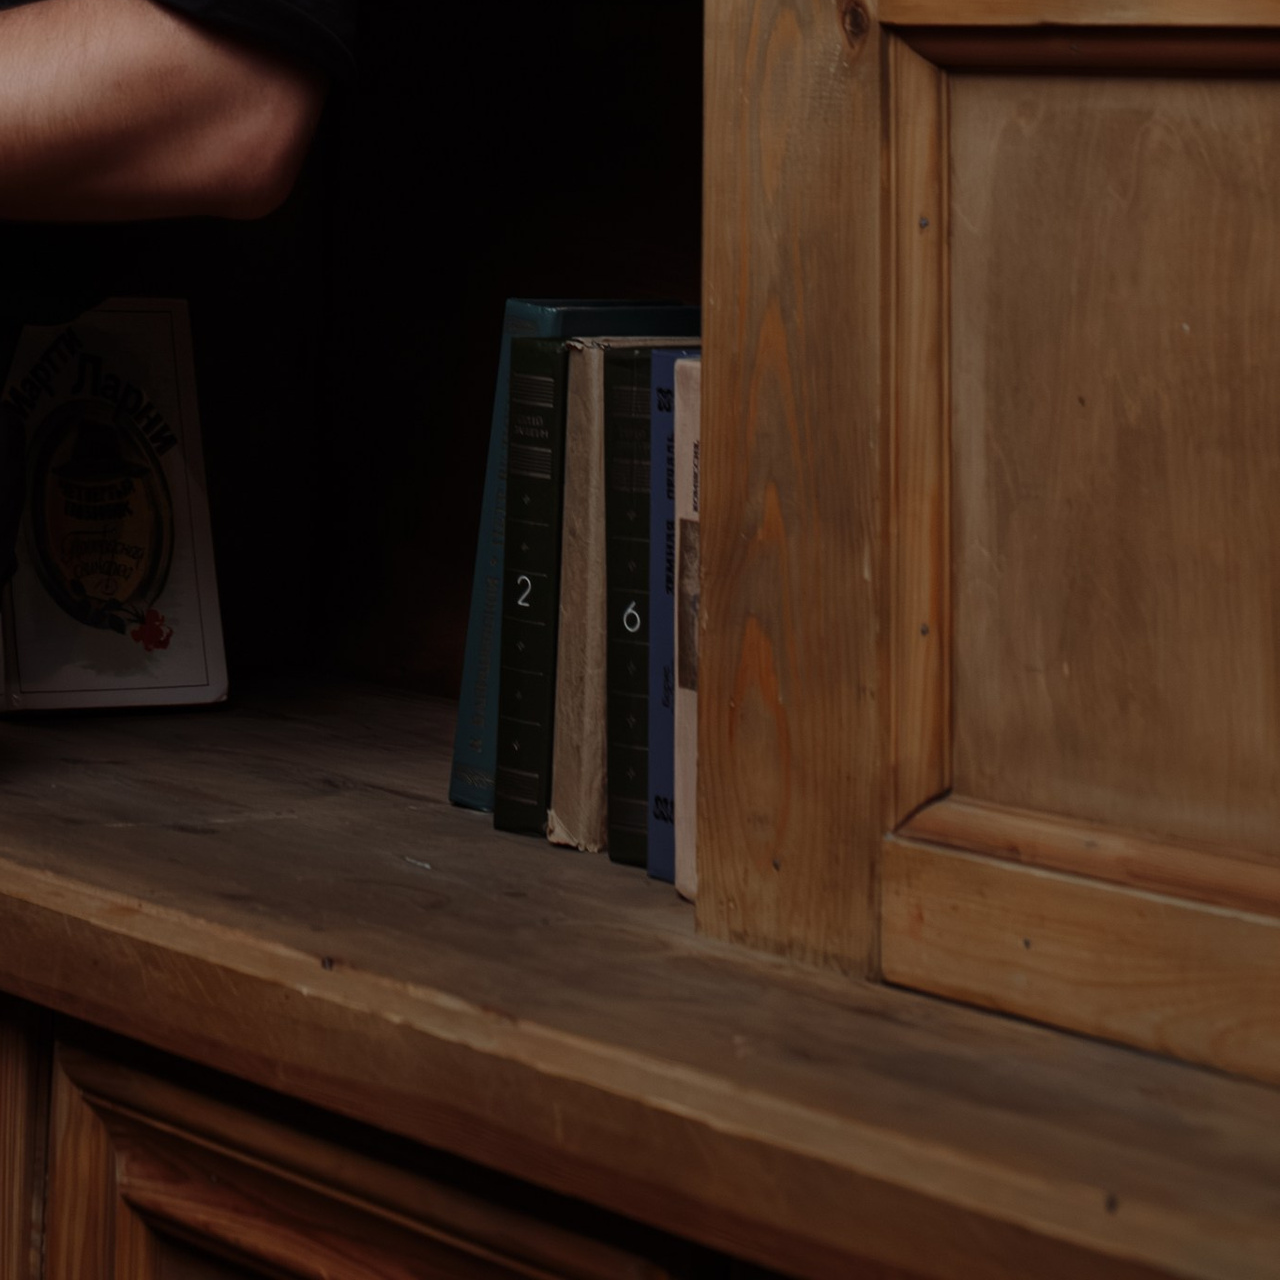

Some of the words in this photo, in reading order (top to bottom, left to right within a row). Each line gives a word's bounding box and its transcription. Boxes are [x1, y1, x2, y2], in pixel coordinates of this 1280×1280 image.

[71, 352, 178, 456] Ларни
[517, 575, 532, 607] 2
[623, 600, 640, 633] 6
